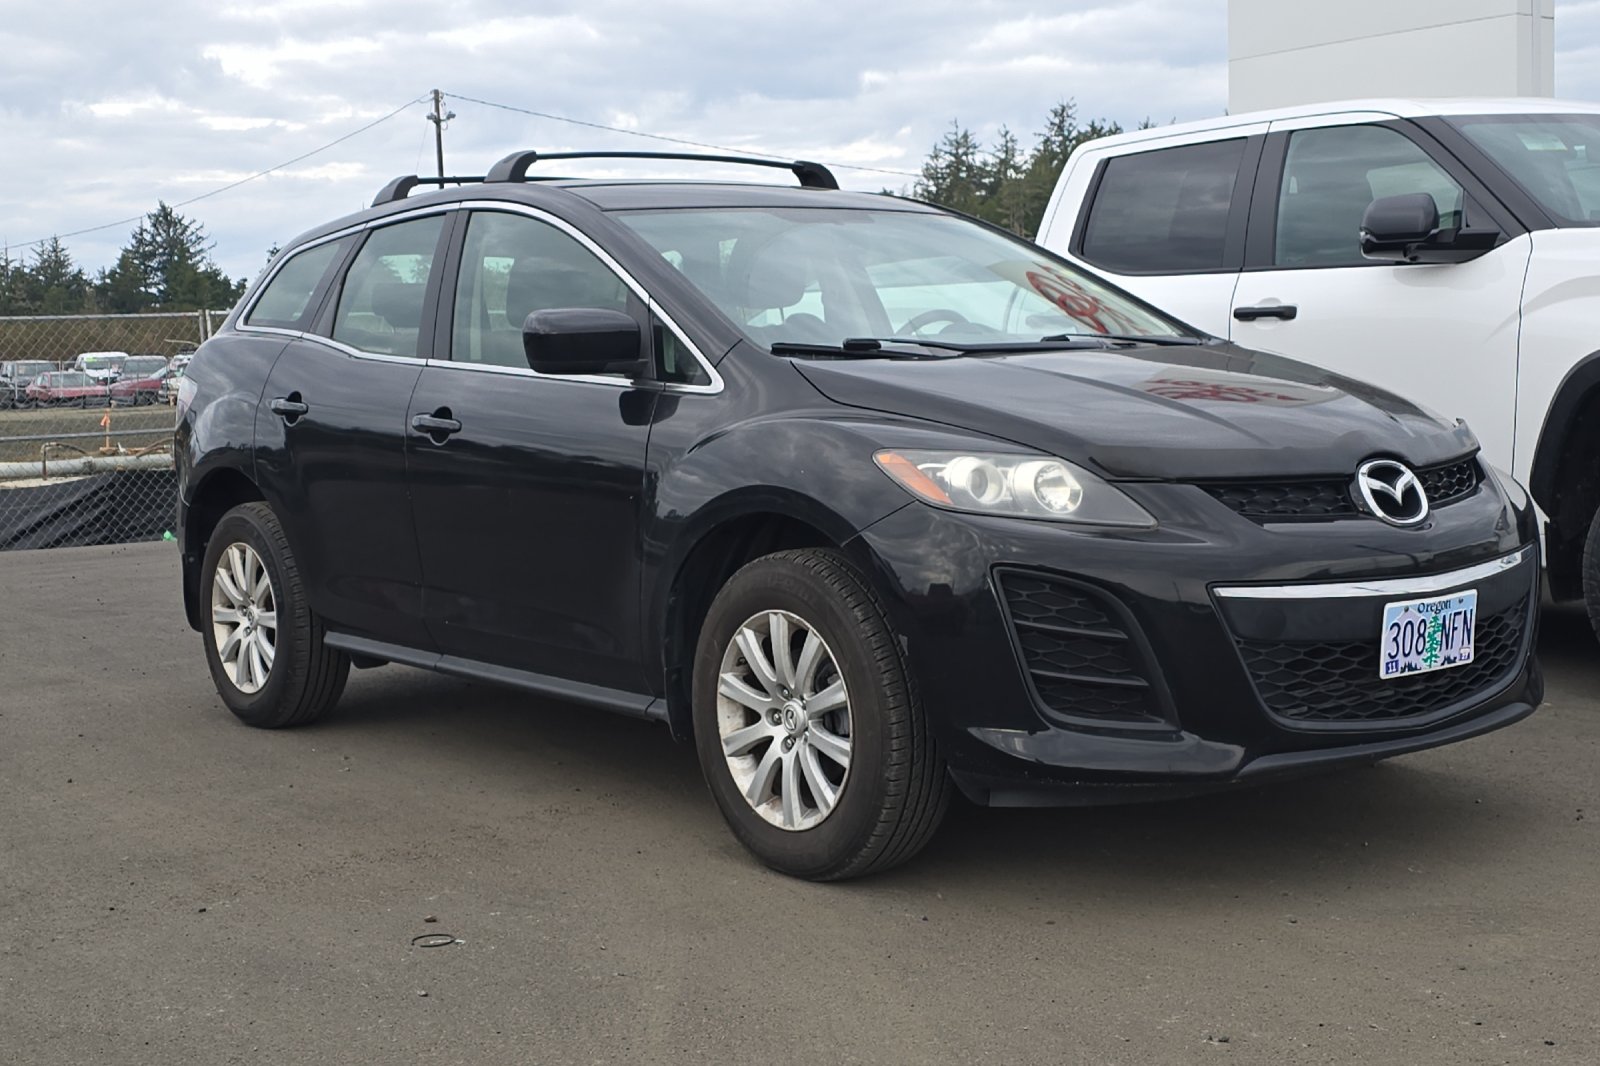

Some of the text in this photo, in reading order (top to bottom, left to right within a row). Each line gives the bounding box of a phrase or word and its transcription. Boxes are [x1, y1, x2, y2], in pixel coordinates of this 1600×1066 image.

[1418, 599, 1451, 614] Oregon
[1388, 608, 1473, 659] 308 NFN
